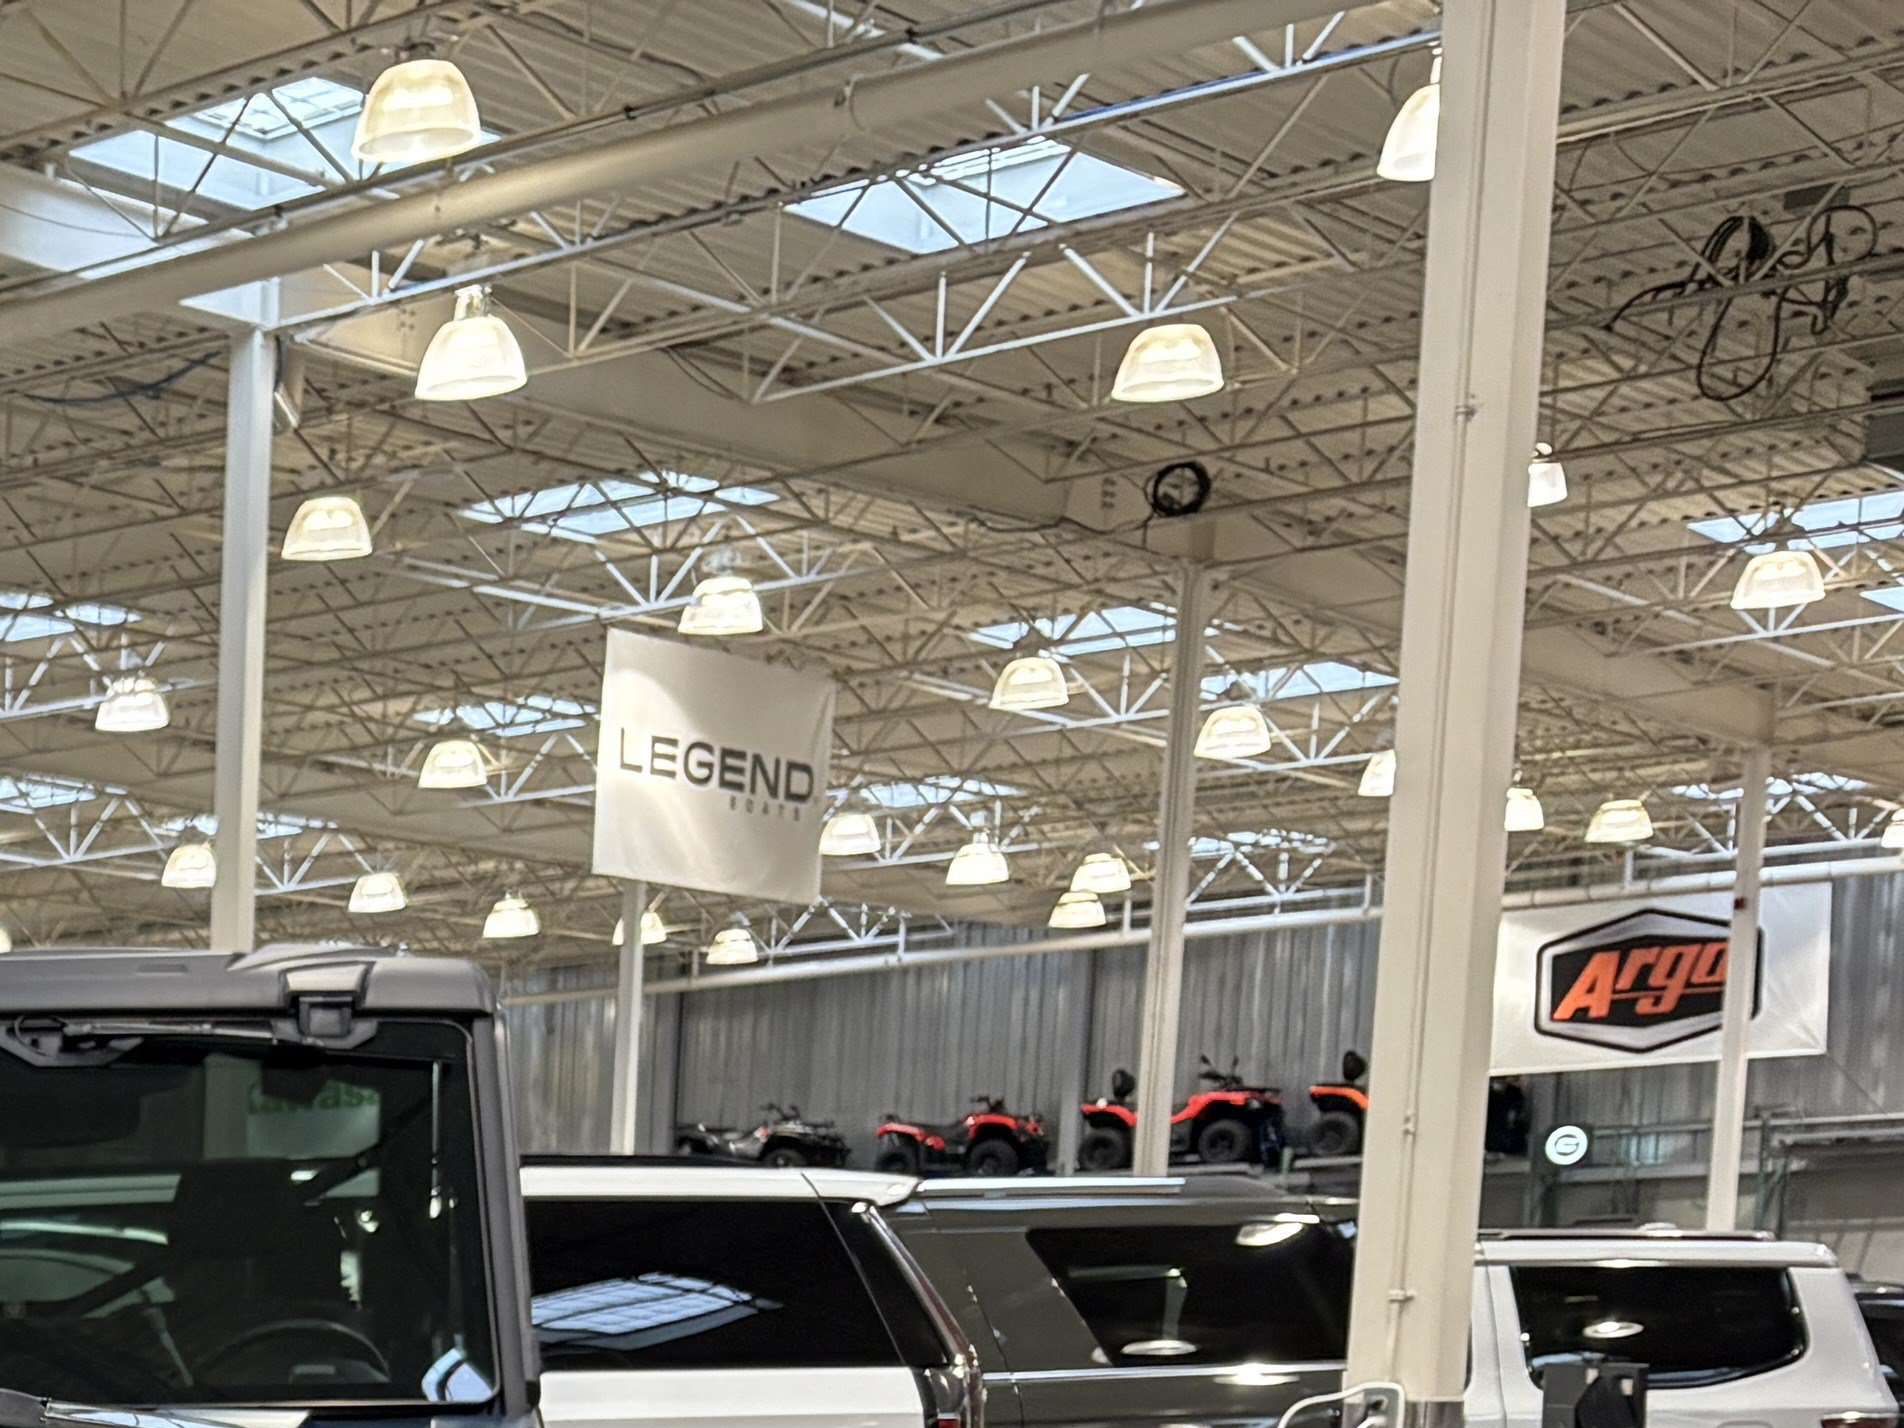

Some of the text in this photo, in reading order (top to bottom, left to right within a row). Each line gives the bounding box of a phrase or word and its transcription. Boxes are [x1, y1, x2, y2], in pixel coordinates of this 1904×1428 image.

[619, 727, 814, 804] LEGEND
[729, 795, 801, 822] BOATS
[1552, 942, 1729, 1021] Argo
